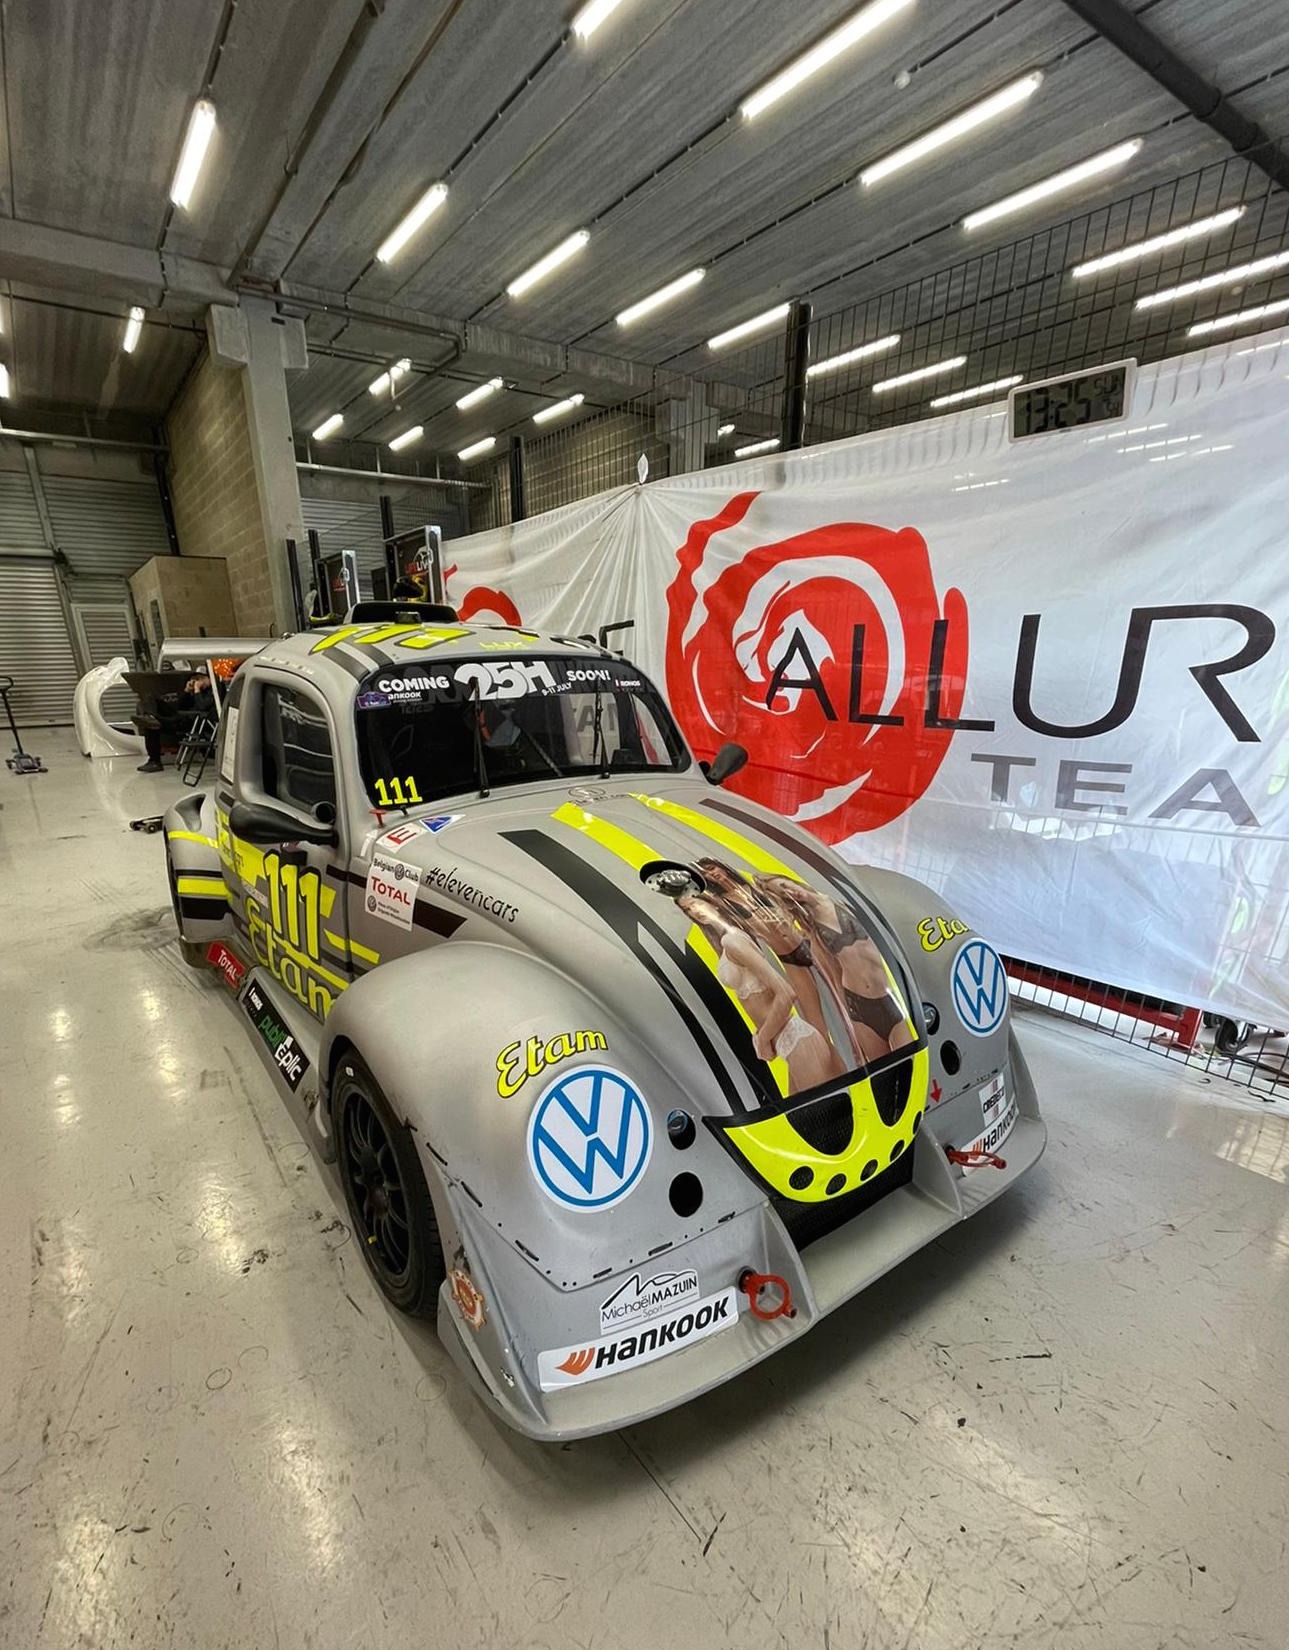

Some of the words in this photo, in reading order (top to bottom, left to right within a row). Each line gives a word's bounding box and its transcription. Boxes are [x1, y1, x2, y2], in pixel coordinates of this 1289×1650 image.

[1025, 377, 1093, 433] 13:25
[378, 676, 450, 692] COMING
[453, 661, 556, 701] 25H
[556, 682, 572, 693] JULY
[566, 669, 611, 681] SOON!
[765, 603, 1276, 743] ALLUR
[374, 776, 423, 806] 111
[970, 753, 1262, 828] TEA
[373, 858, 395, 873] Belgian
[404, 869, 419, 882] Club
[263, 850, 321, 964] 111
[371, 876, 411, 906] TOTAL
[425, 867, 519, 923] #elevencars
[917, 917, 969, 952] Eta
[216, 950, 237, 980] TOTAL
[496, 1030, 608, 1099] Etam
[642, 1304, 663, 1318] Sport
